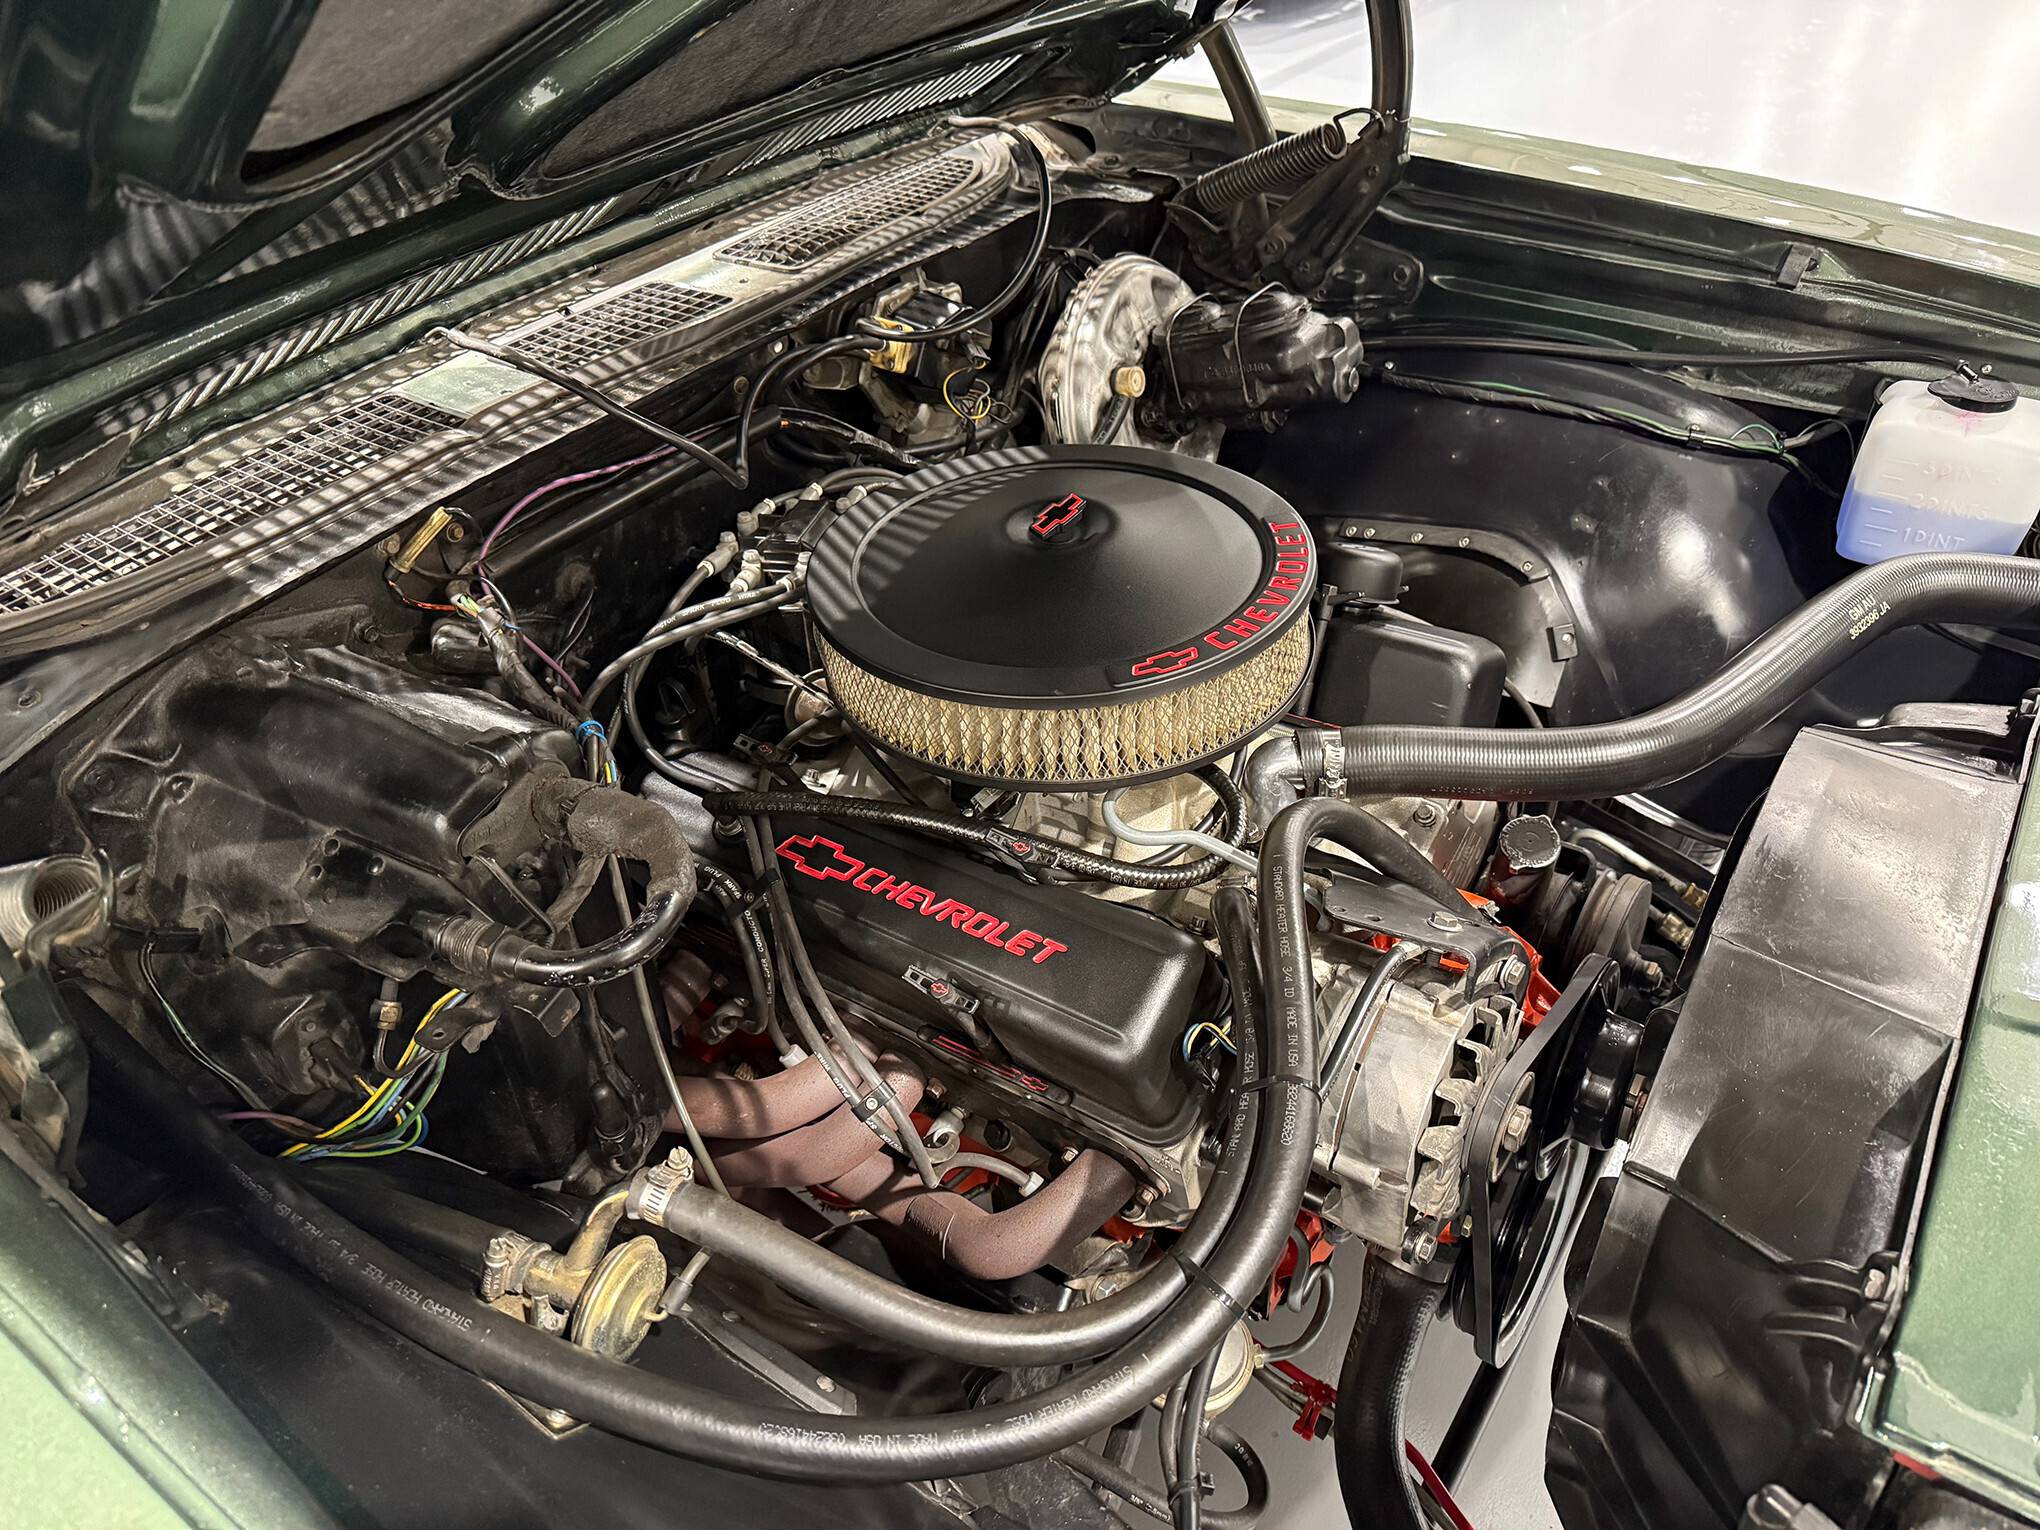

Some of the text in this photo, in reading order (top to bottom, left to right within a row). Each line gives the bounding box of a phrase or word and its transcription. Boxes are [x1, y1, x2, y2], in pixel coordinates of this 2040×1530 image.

[1204, 521, 1308, 650] CHEVROLET
[1849, 603, 1866, 620] GM
[1850, 601, 1891, 640] 3932396 JA
[704, 866, 722, 879] PLUG
[1273, 865, 1285, 902] STANDARD
[853, 867, 1069, 964] CHEVROLET
[1276, 903, 1289, 935] HEATER
[744, 909, 764, 953] CONDUCTO
[1280, 936, 1291, 958] HOSE
[1282, 966, 1294, 983] 3/4
[1284, 987, 1295, 997] ID
[1286, 1006, 1298, 1029] MADE
[1288, 1034, 1298, 1046] IN
[1243, 1051, 1255, 1076] HOSE
[1288, 1050, 1299, 1067] USA
[833, 1076, 851, 1098] PLUG
[1239, 1076, 1252, 1111] HEAR
[360, 1262, 388, 1284] HOSE
[887, 1434, 901, 1447] IN
